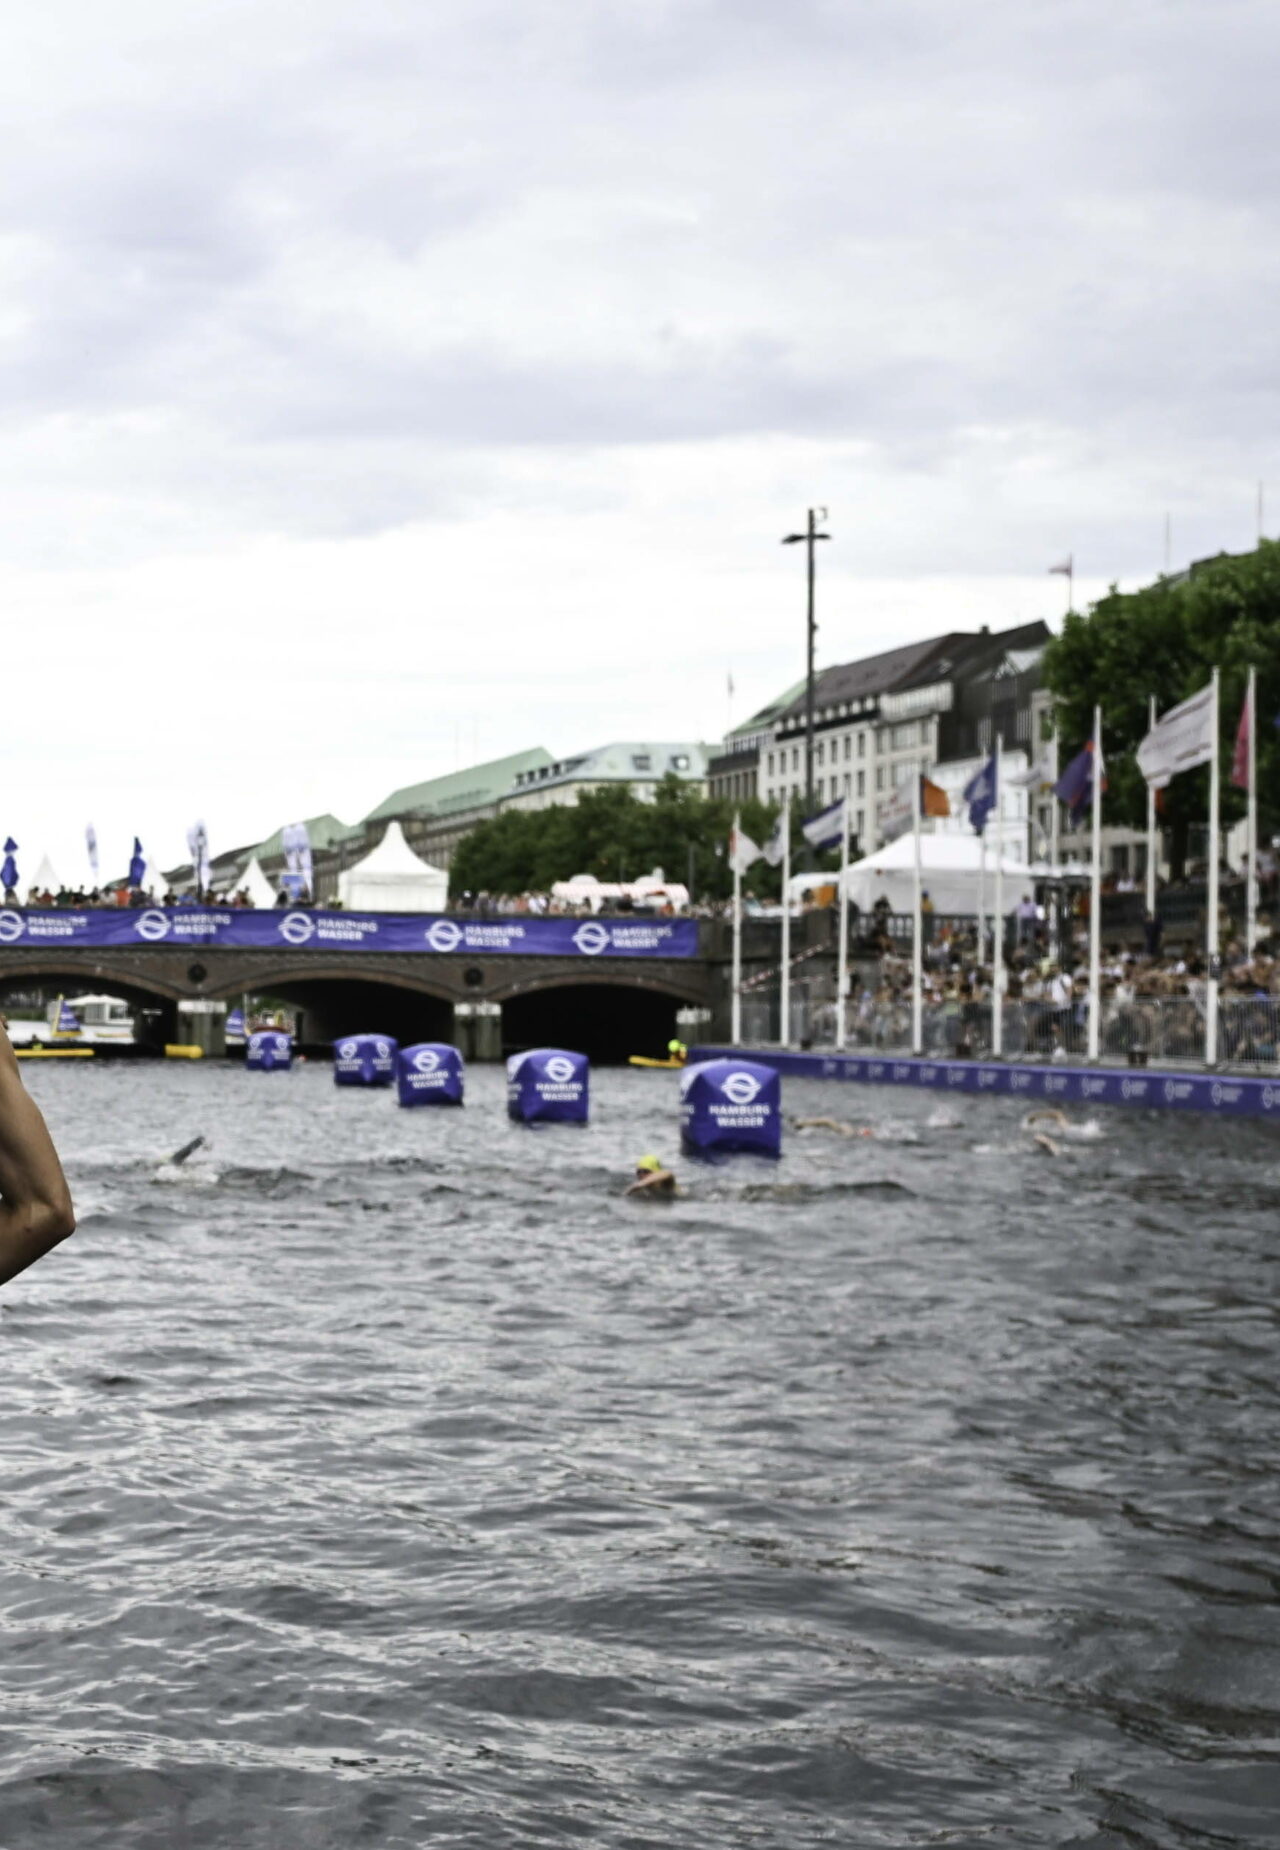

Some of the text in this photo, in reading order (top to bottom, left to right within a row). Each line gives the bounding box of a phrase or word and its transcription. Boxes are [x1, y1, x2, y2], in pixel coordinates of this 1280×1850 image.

[28, 916, 87, 926] HAMBURG
[174, 914, 231, 925] HAMBURG
[28, 926, 73, 936] WASSER
[174, 924, 217, 935] WASSER
[317, 919, 377, 933] HAMBURG
[318, 929, 363, 941] WASSER
[465, 926, 525, 938] HAMBURG
[612, 927, 673, 938] HAMBURG
[466, 936, 511, 947] WASSER
[613, 938, 658, 949] WASSER
[407, 1071, 449, 1081] HAMBURG
[412, 1079, 446, 1089] WASSER
[535, 1082, 583, 1092] HAMBURG
[542, 1092, 579, 1101] WASSER
[709, 1104, 770, 1115] HAMBURG
[717, 1117, 764, 1128] WASSER
